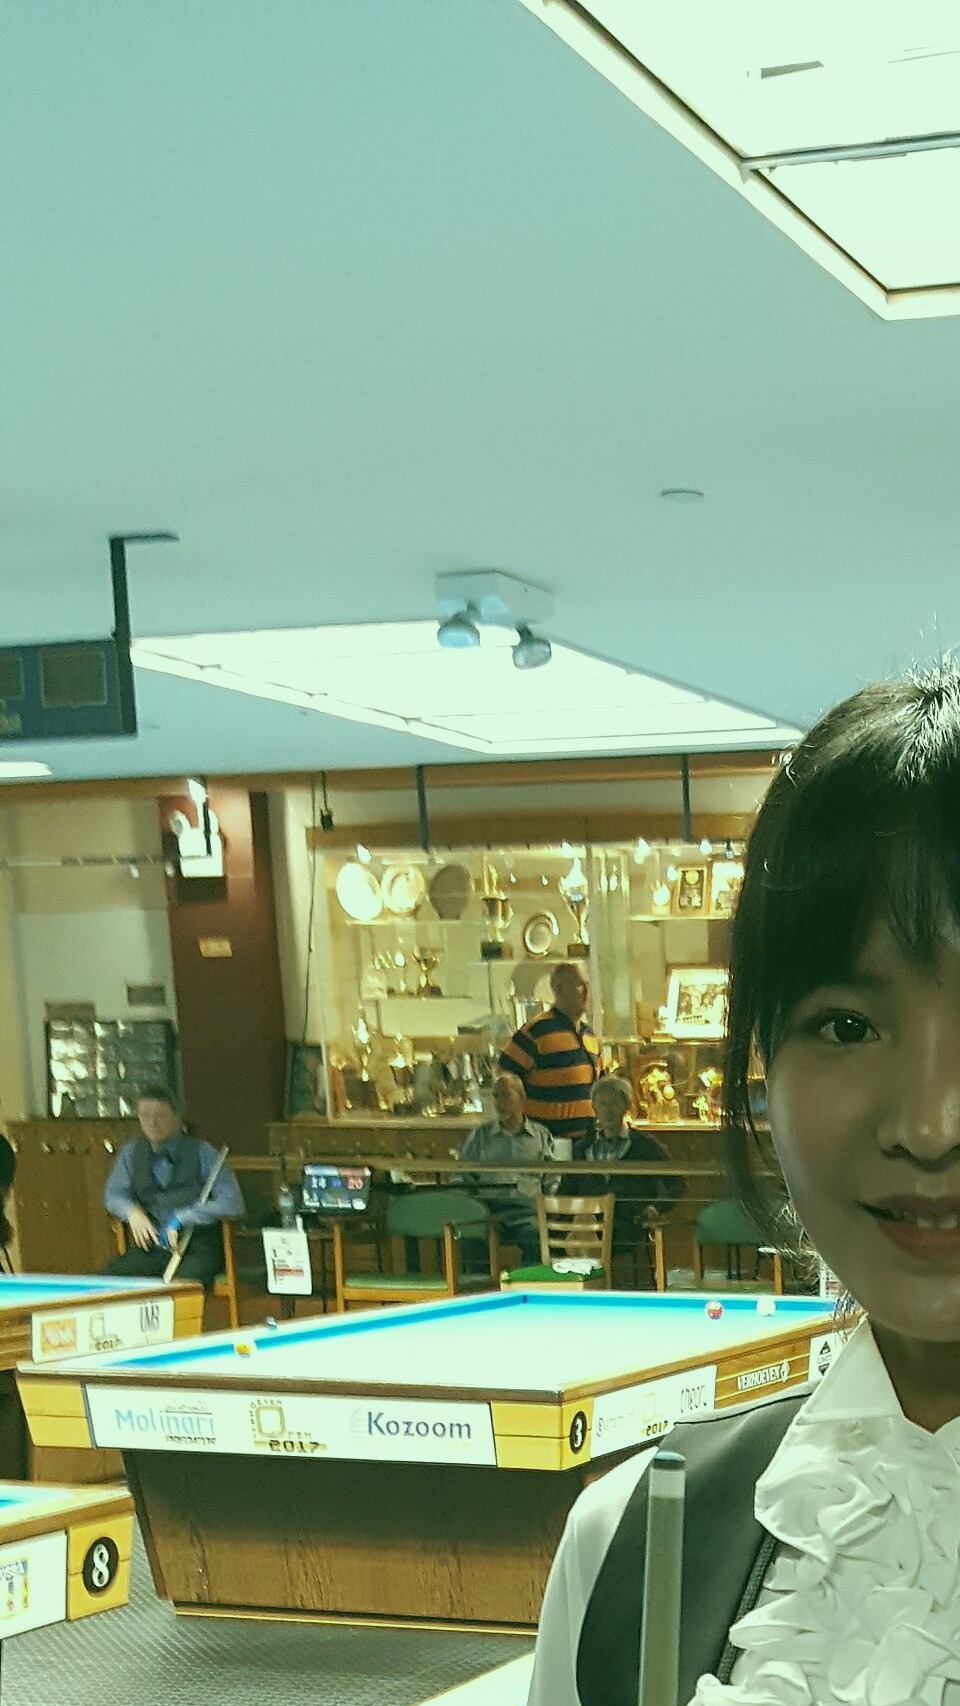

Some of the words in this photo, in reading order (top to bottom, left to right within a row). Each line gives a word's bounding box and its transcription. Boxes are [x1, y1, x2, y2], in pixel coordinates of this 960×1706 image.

[738, 1364, 782, 1391] VERHOEVEN
[114, 1408, 216, 1436] Molinari
[367, 1411, 472, 1440] Kozoom
[268, 1439, 320, 1454] 2017
[92, 1543, 110, 1588] 8
